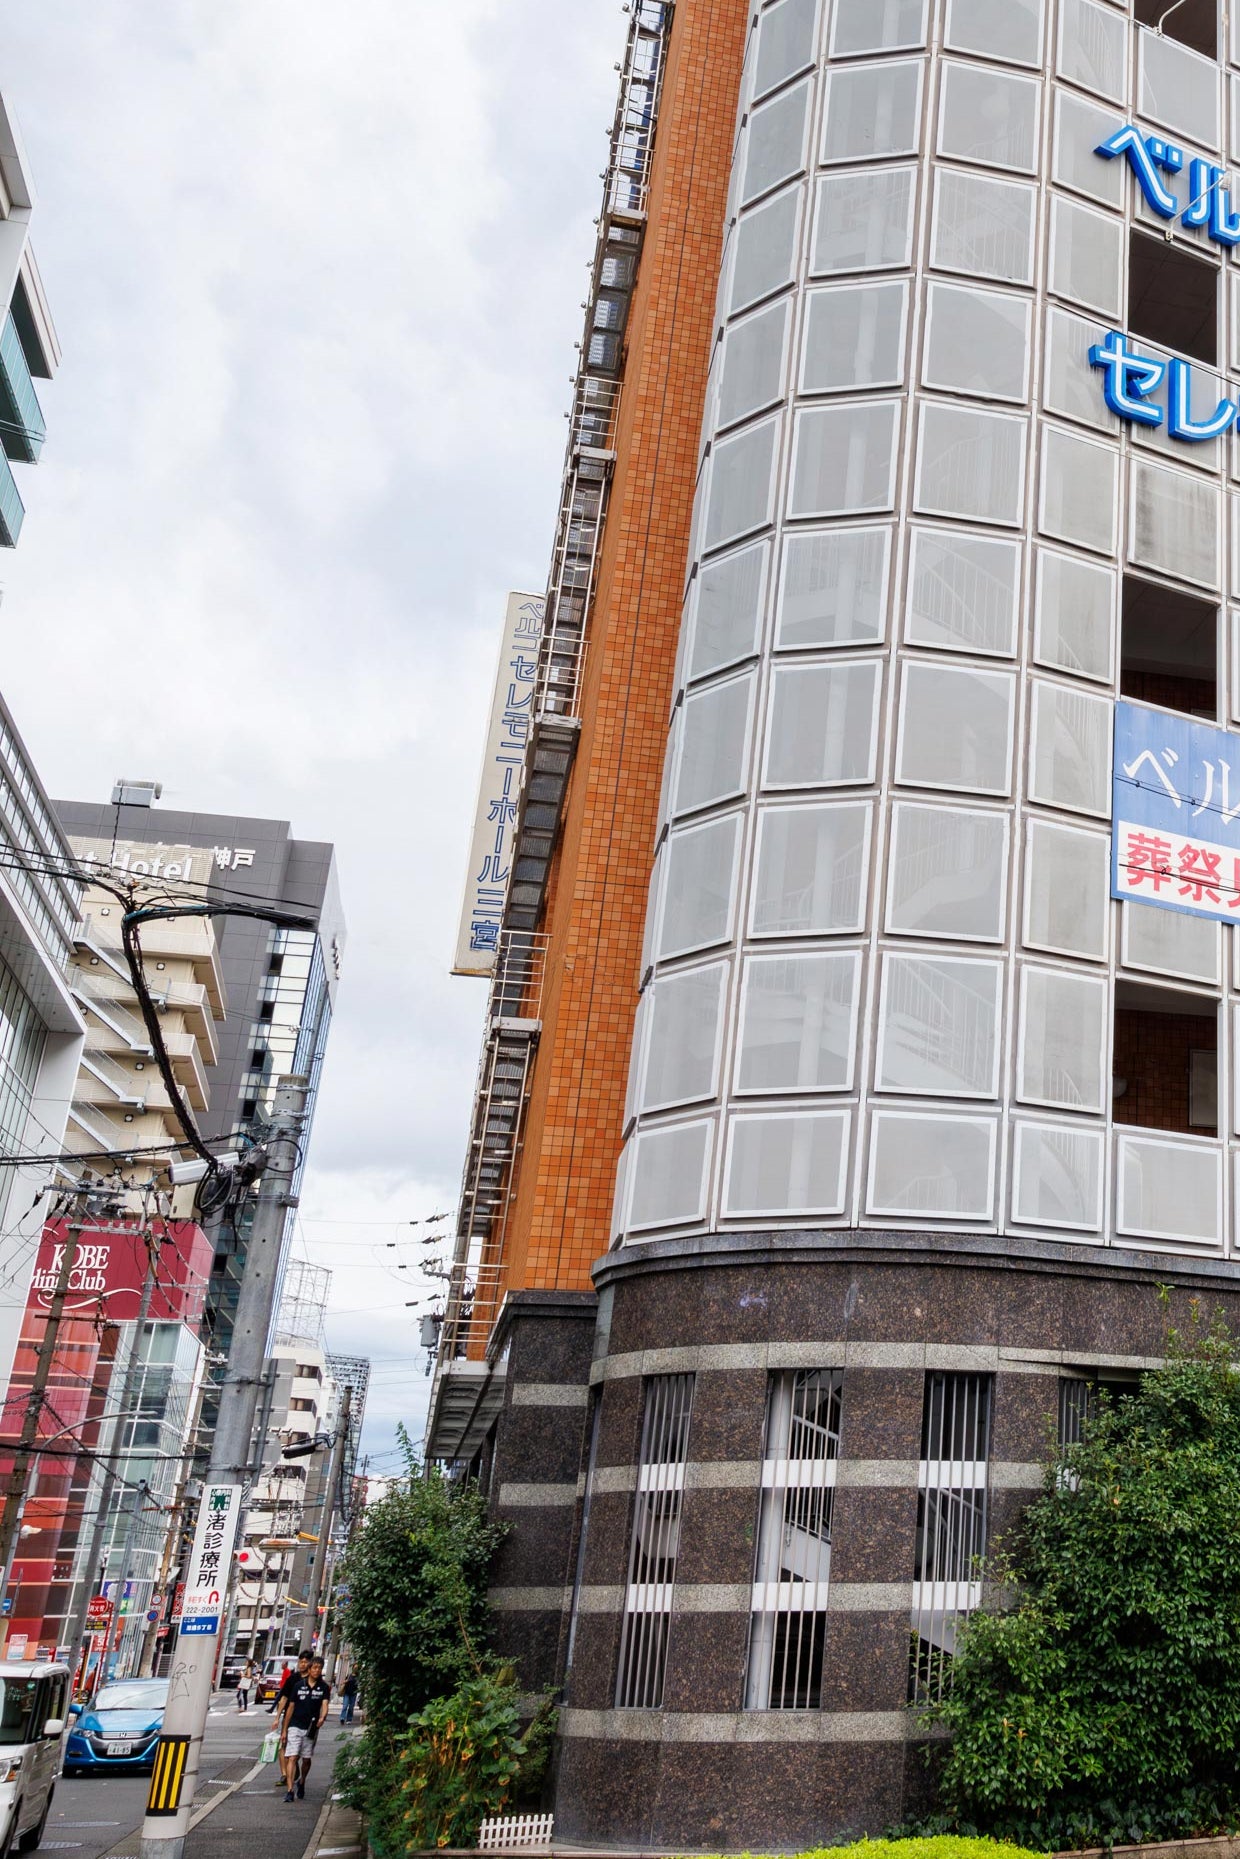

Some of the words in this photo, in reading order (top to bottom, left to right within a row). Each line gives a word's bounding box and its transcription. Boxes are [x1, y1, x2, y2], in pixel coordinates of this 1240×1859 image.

[112, 849, 193, 883] Hotel
[67, 1269, 106, 1291] Club
[196, 1512, 227, 1587] 渚診療所
